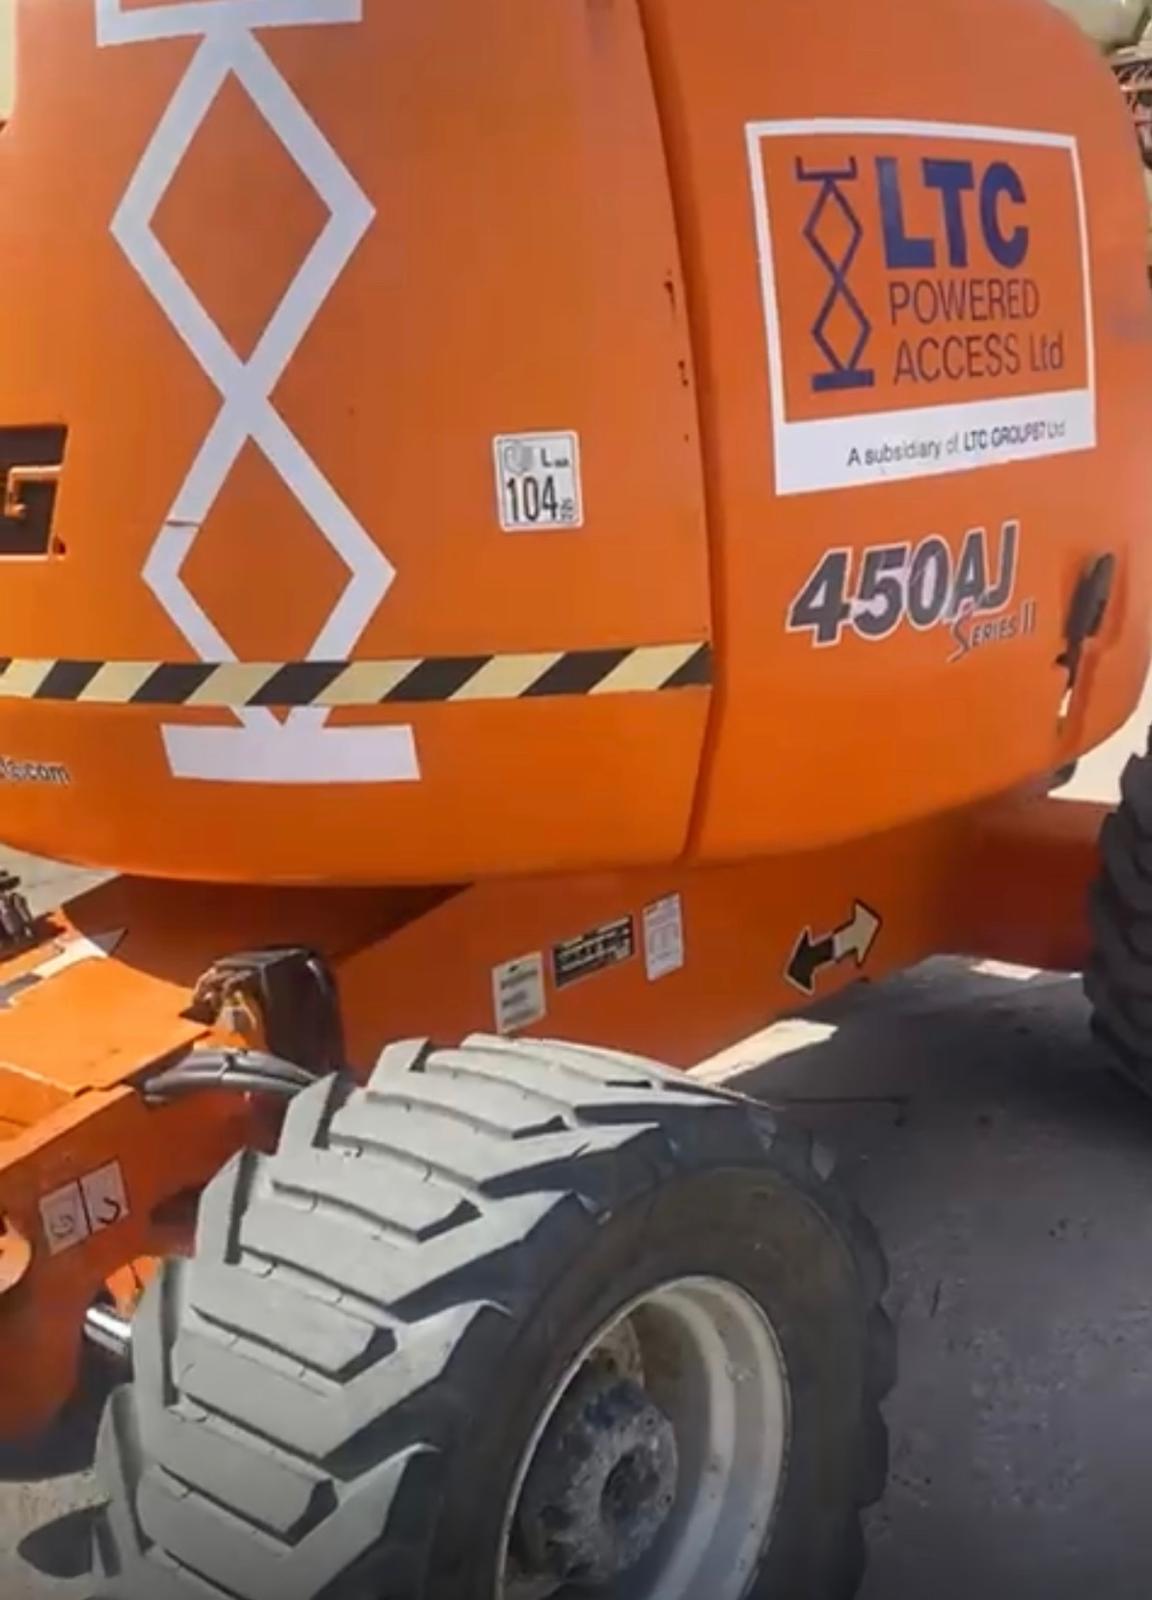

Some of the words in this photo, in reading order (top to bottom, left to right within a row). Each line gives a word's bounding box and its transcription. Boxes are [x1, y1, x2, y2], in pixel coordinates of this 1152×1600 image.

[875, 156, 1030, 269] LTC
[889, 279, 1040, 326] POWERED
[893, 334, 1021, 386] ACCESS
[1029, 332, 1064, 373] Ltd
[847, 447, 861, 467] A
[864, 438, 941, 467] subsidiary
[945, 432, 960, 453] of
[963, 428, 987, 452] LTC
[506, 475, 559, 522] 104
[786, 520, 1019, 647] 450AJ
